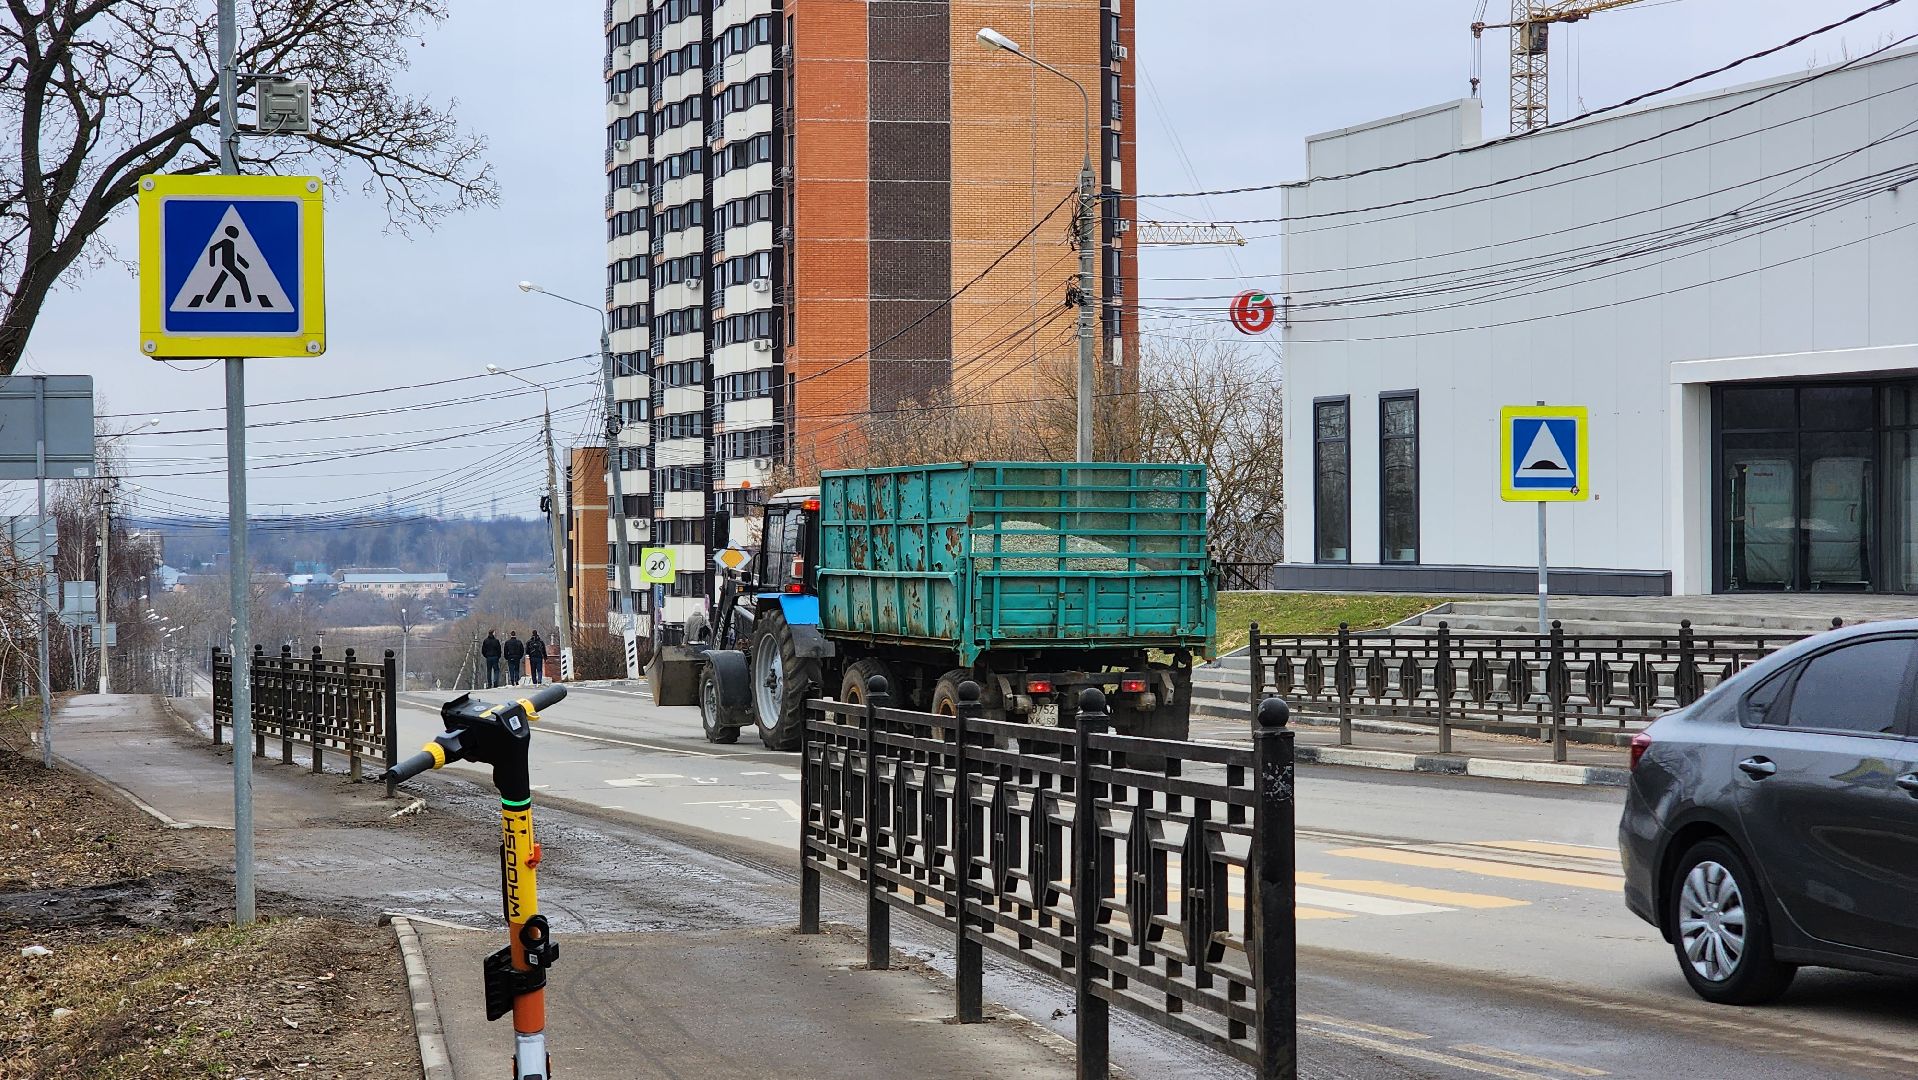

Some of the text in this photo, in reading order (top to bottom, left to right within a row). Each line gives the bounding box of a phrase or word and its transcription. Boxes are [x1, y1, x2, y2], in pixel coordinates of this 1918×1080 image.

[1245, 294, 1269, 327] 5
[650, 560, 666, 571] 20
[503, 816, 521, 918] WHOOSH
